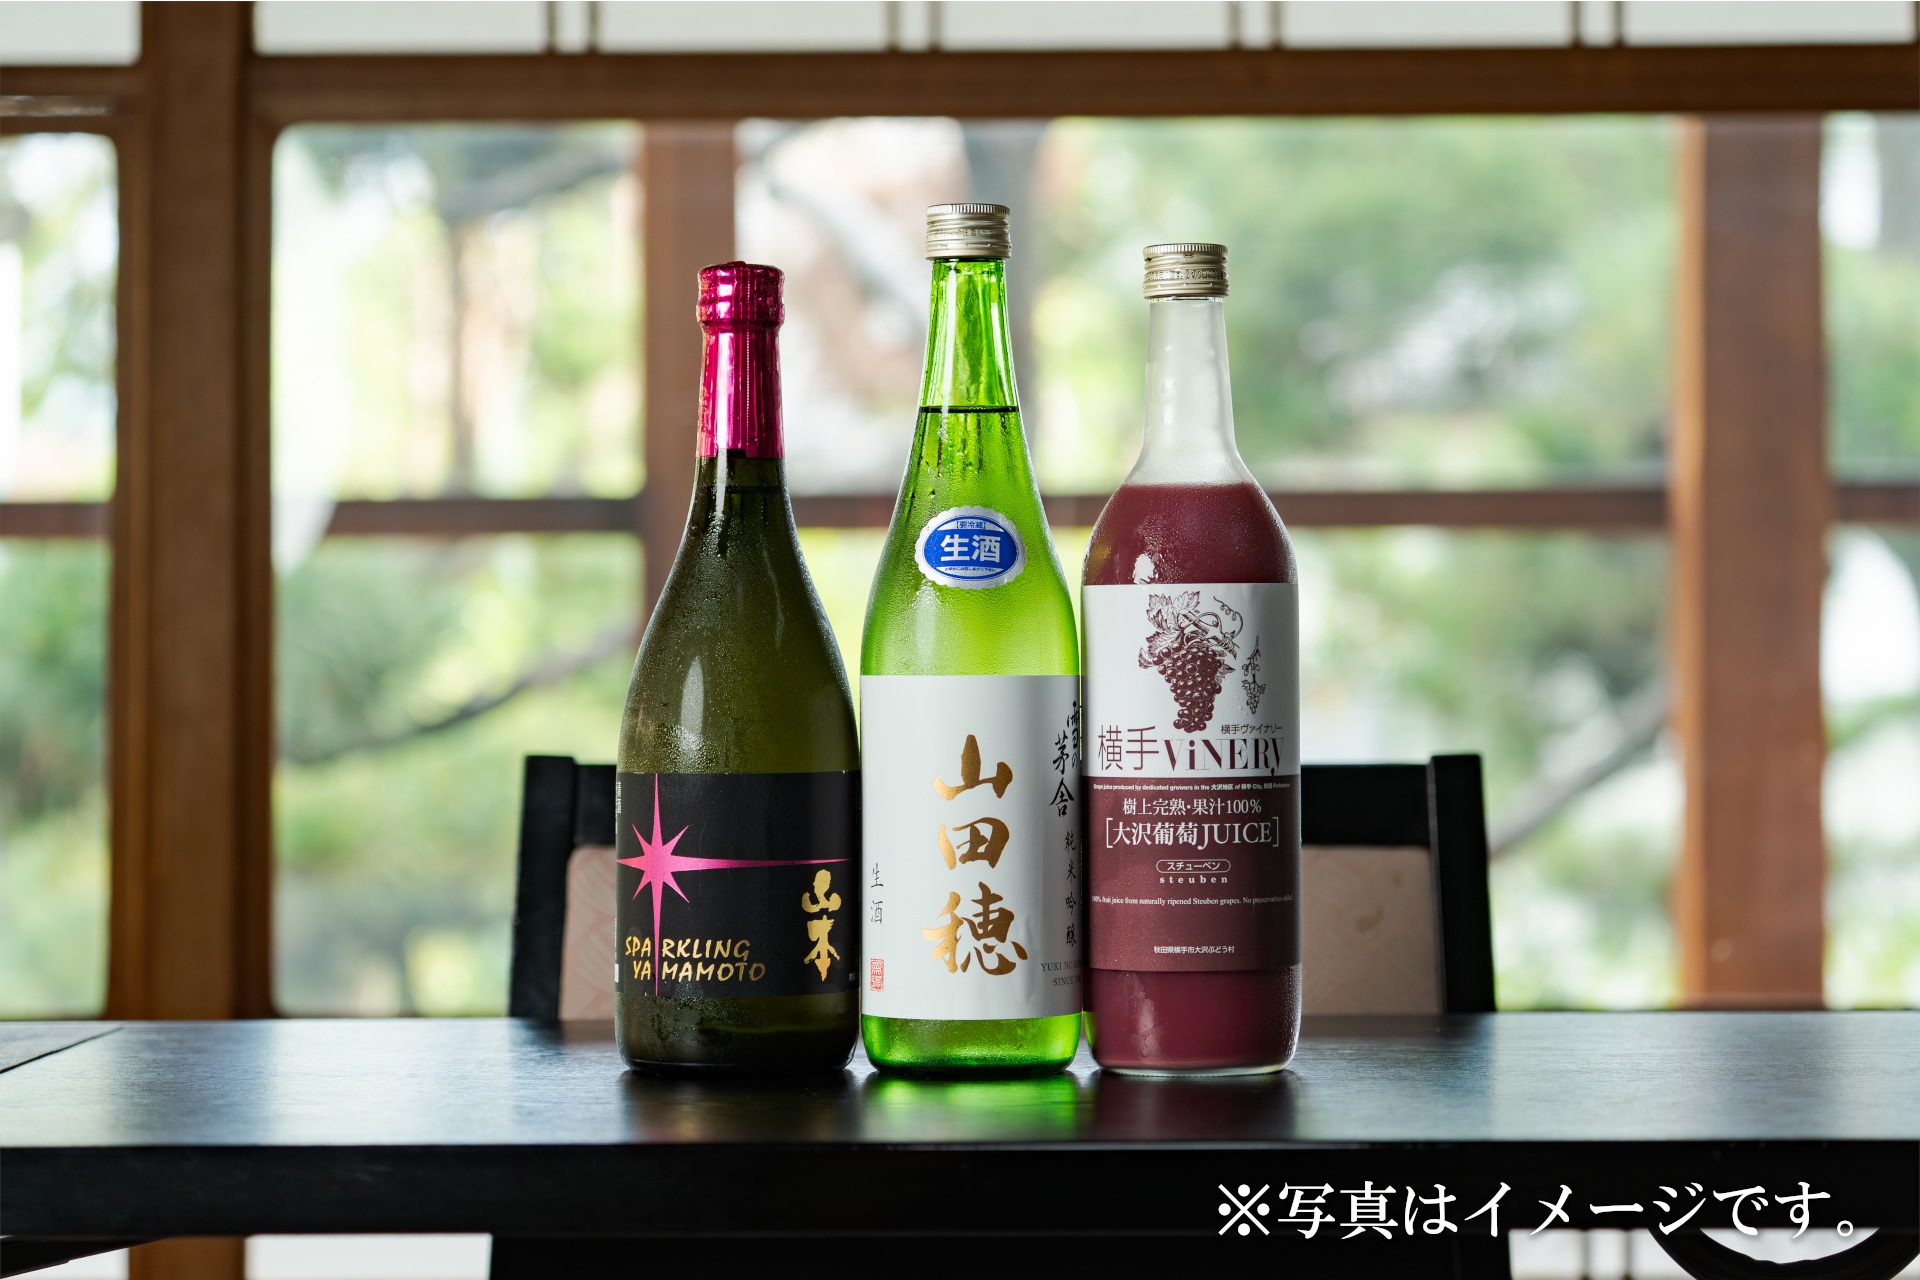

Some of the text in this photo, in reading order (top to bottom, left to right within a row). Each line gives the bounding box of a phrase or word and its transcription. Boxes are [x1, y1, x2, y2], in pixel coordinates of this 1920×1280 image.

[940, 534, 1001, 562] 生酒
[1220, 723, 1284, 735] 横手ヴァイナリー
[1097, 724, 1160, 771] 横手
[921, 734, 1029, 976] 山田穂
[1166, 861, 1221, 871] スチューベン
[1159, 875, 1229, 884] steuben
[870, 862, 884, 926] 生酒
[1111, 896, 1124, 905] juice
[1124, 896, 1139, 904] from
[1139, 897, 1166, 906] naturally
[1167, 897, 1192, 906] ripened
[1192, 897, 1218, 905] Steuben
[1219, 898, 1242, 906] grapes.
[1242, 896, 1252, 904] No
[801, 868, 842, 982] 山本
[624, 935, 751, 961] SPARKLING
[632, 960, 767, 983] YAMAMOTO
[1041, 962, 1063, 971] YUKI
[1053, 976, 1074, 986] SINCE
